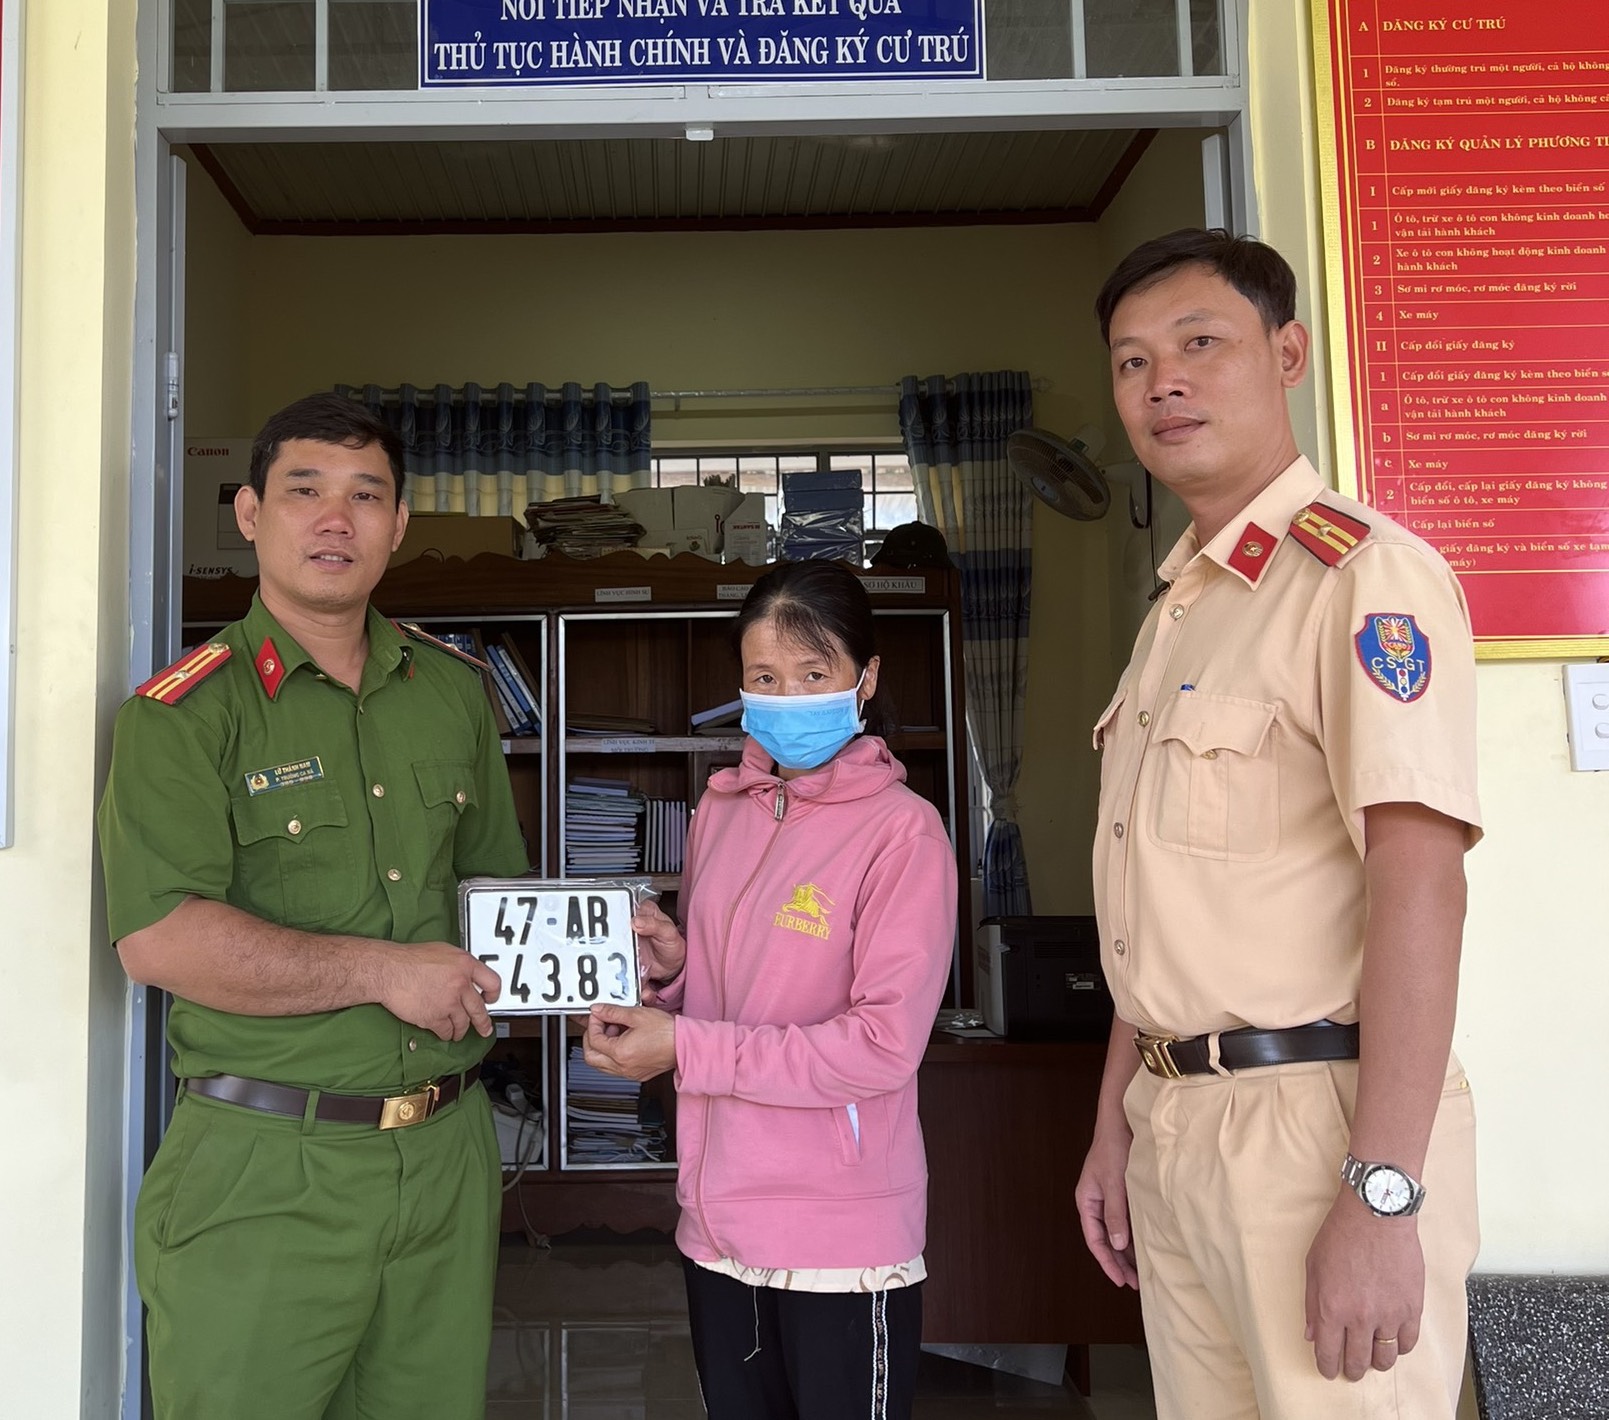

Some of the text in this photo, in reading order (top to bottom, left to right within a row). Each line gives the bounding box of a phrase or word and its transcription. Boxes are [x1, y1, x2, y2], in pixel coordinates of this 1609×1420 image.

[1358, 21, 1369, 32] A
[1383, 16, 1505, 30] ĐĂNG KÝ CƯ TRÚ
[434, 26, 969, 76] THỦ TỤC HÀNH CHÍNH VÀ ĐĂNG KÝ CƯ TRÚ
[1363, 68, 1369, 78] 1
[1386, 65, 1411, 74] Đăng
[1431, 64, 1467, 73] thường
[1471, 63, 1486, 72] trú
[1490, 63, 1509, 72] một
[1513, 62, 1544, 72] người,
[1562, 61, 1576, 71] hộ
[1386, 77, 1399, 86] số.
[1364, 97, 1372, 108] 2
[1388, 97, 1414, 107] Đăng
[1433, 98, 1452, 106] tạm
[1456, 97, 1471, 105] trú
[1476, 96, 1494, 105] một
[1499, 95, 1530, 105] người,
[1547, 94, 1562, 104] hộ
[1565, 94, 1597, 103] không
[1365, 139, 1376, 150] B
[1391, 137, 1430, 150] ĐĂNG
[1435, 136, 1455, 149] KÝ
[1460, 134, 1500, 151] QUẢN
[1505, 135, 1523, 148] LÝ
[1529, 135, 1590, 147] PHƯƠNG
[1392, 185, 1413, 196] Cấp
[1417, 186, 1436, 194] mới
[1440, 184, 1462, 196] giấy
[1466, 185, 1492, 195] đăng
[1513, 184, 1535, 193] kèm
[1539, 184, 1562, 192] theo
[1566, 181, 1589, 192] biển
[1592, 181, 1606, 191] số
[1394, 212, 1403, 222] Ô
[1406, 214, 1419, 223] tô,
[1423, 214, 1438, 222] trừ
[1456, 214, 1464, 222] ô
[1465, 213, 1477, 222] tô
[1501, 212, 1533, 222] không
[1537, 212, 1559, 220] kinh
[1563, 211, 1595, 220] doanh
[1371, 220, 1377, 231] 1
[1396, 226, 1495, 237] vận tải hành khách
[1396, 248, 1410, 257] Xe
[1411, 248, 1419, 257] ô
[1421, 248, 1433, 256] tô
[1457, 247, 1489, 257] không
[1492, 247, 1514, 257] hoạt
[1518, 246, 1544, 256] động
[1547, 246, 1570, 254] kinh
[1574, 245, 1606, 254] doanh
[1372, 254, 1381, 265] 2
[1398, 261, 1457, 270] hành khách
[1376, 340, 1387, 352] II
[1401, 340, 1422, 351] Cấp
[1425, 340, 1442, 349] đổi
[1446, 339, 1468, 351] giấy
[1472, 340, 1498, 350] đăng
[188, 446, 229, 456] Canon
[1384, 459, 1392, 468] c
[1408, 459, 1447, 469] Xe máy
[1410, 481, 1431, 492] Cấp
[1435, 480, 1455, 490] đổi,
[1458, 480, 1478, 492] cấp
[1481, 480, 1495, 491] lại
[1499, 480, 1521, 491] giấy
[1525, 480, 1552, 490] đăng
[1573, 479, 1607, 489] không
[1386, 489, 1395, 500] 2
[1411, 495, 1434, 504] biển
[1437, 494, 1451, 504] số
[1453, 495, 1461, 504] ô
[1464, 495, 1478, 504] tô,
[1497, 495, 1520, 505] máy
[1413, 517, 1495, 530] Cấp lại biển số
[1439, 542, 1462, 555] giấy
[1466, 543, 1493, 553] đăng
[1513, 543, 1527, 551] và
[1531, 541, 1554, 550] biển
[1557, 540, 1571, 550] số
[1449, 558, 1475, 569] máy)
[1372, 656, 1425, 672] CSGT
